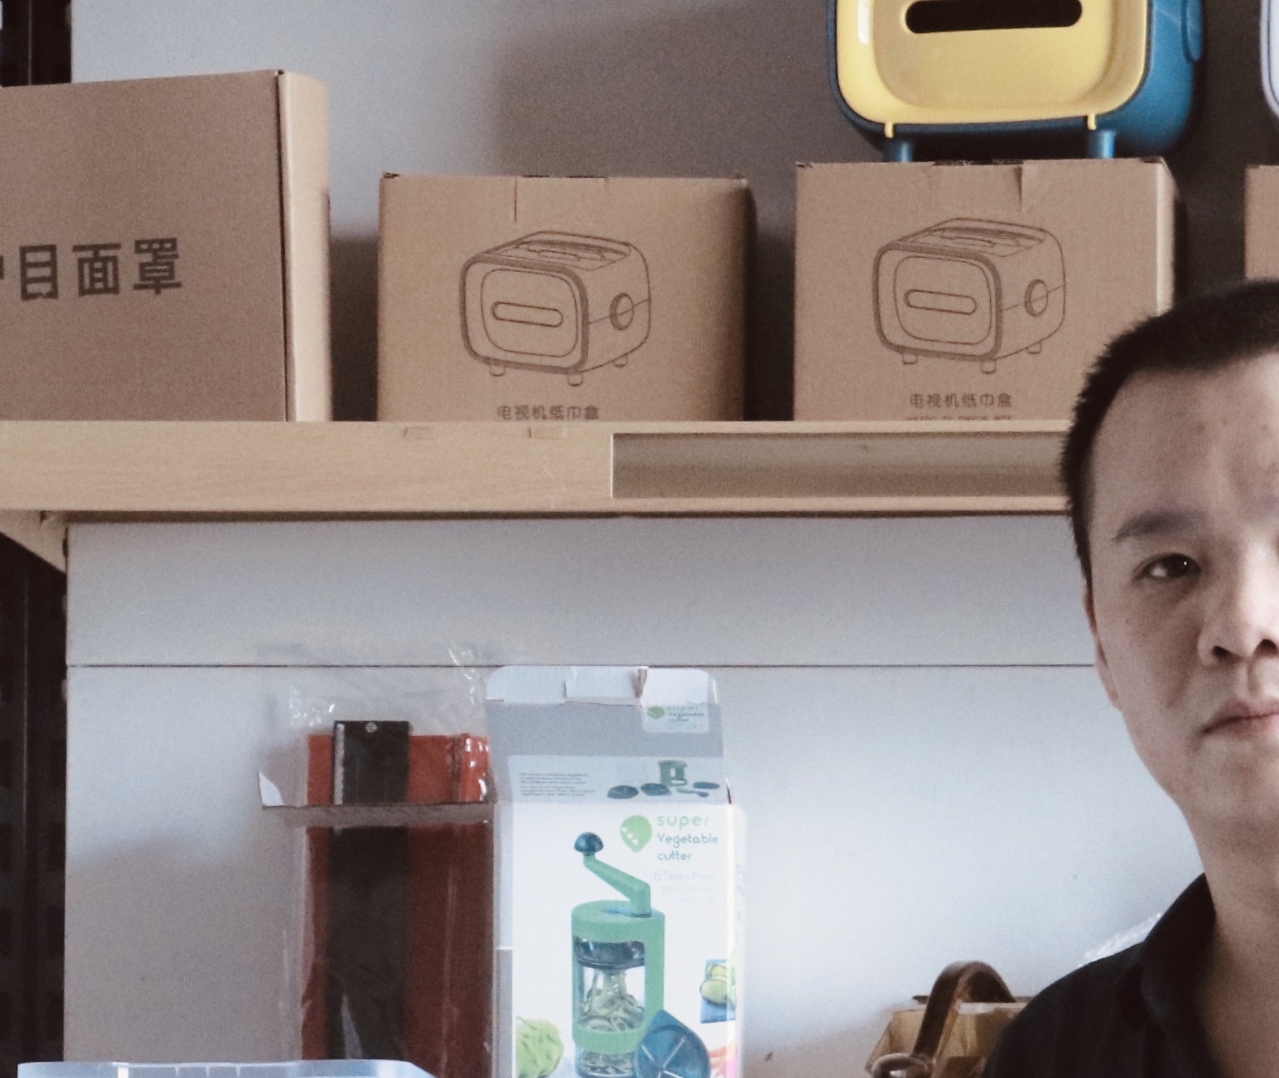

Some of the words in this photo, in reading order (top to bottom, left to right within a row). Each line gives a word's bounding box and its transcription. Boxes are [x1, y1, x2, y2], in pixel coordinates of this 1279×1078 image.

[909, 392, 1013, 409] 电视机纸巾盒
[496, 404, 600, 420] 电视机纸巾盒
[657, 816, 710, 830] super
[657, 833, 719, 849] Vegetable
[657, 850, 692, 861] cutter
